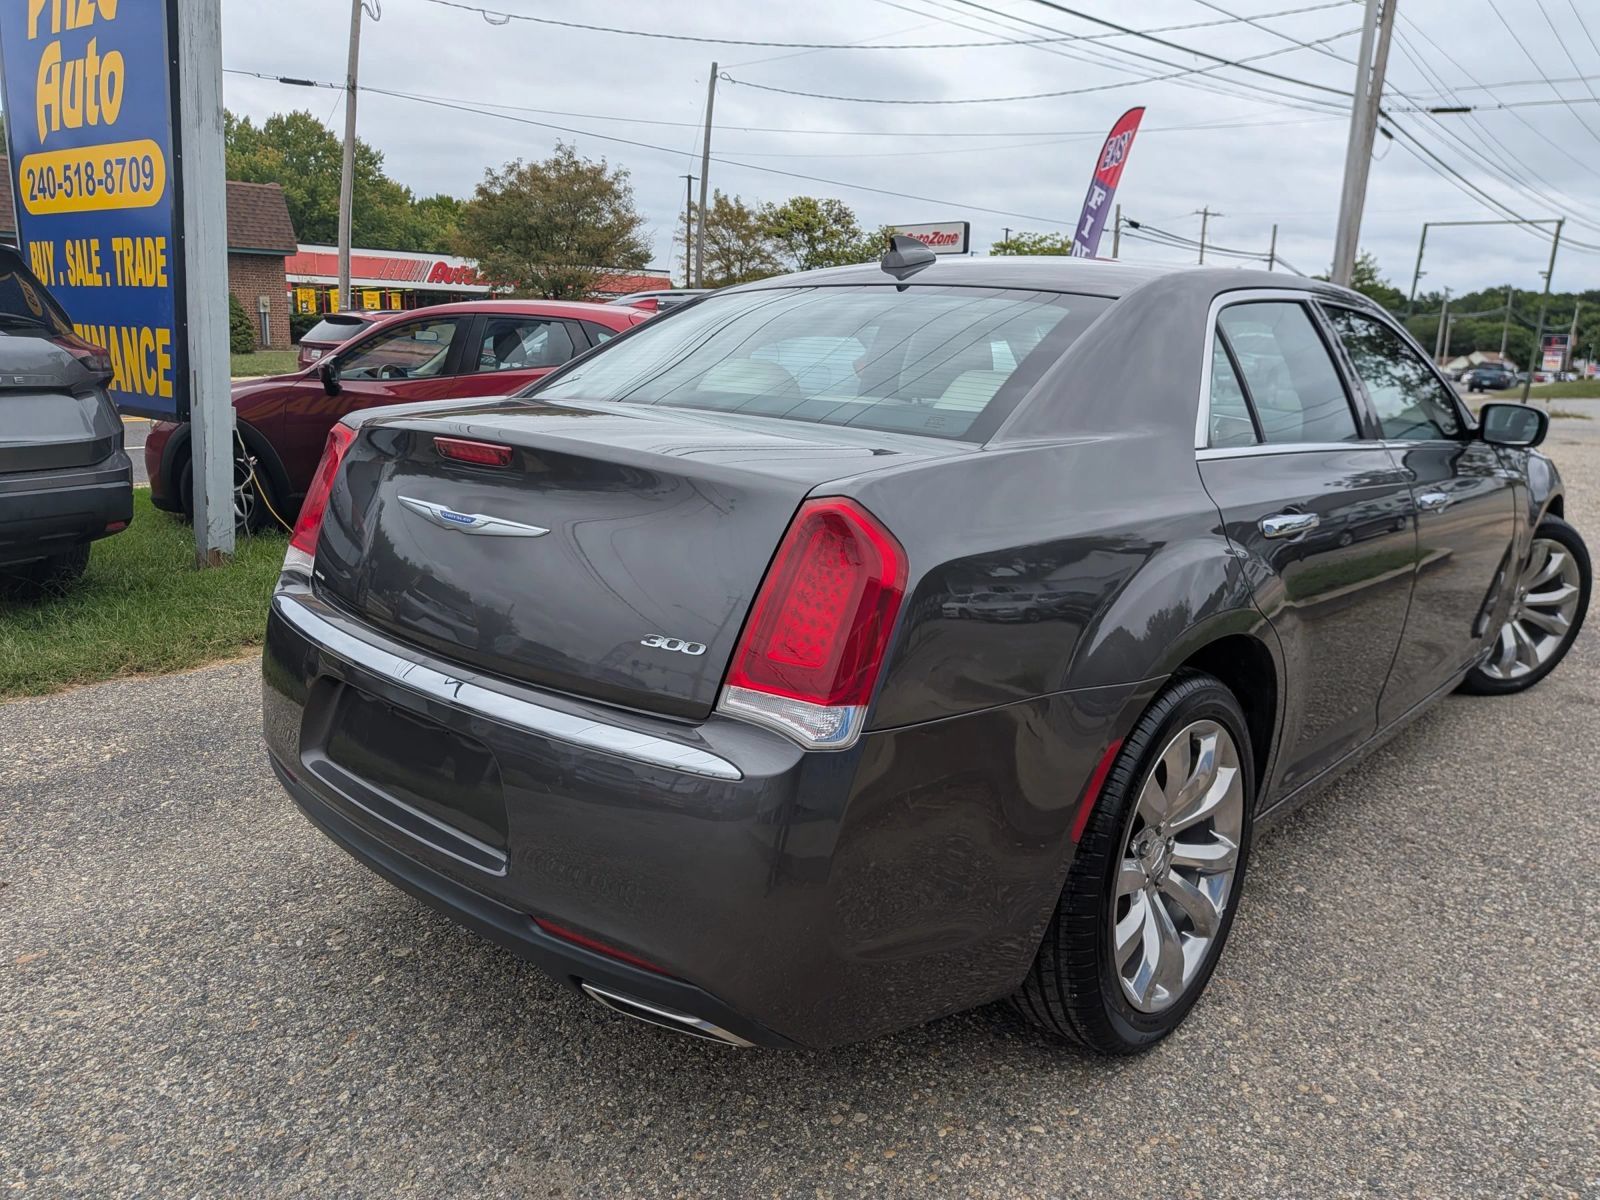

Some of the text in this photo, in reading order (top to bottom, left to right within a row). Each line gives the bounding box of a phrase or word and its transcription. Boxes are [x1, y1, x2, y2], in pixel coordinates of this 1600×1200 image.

[36, 36, 125, 145] Auto
[27, 155, 154, 202] 240-518-8709
[29, 241, 56, 287] BUY
[65, 238, 103, 287] SALE
[111, 236, 168, 288] TRADE
[907, 231, 960, 246] toZone
[73, 323, 173, 398] ANCE
[640, 633, 707, 656] 300
